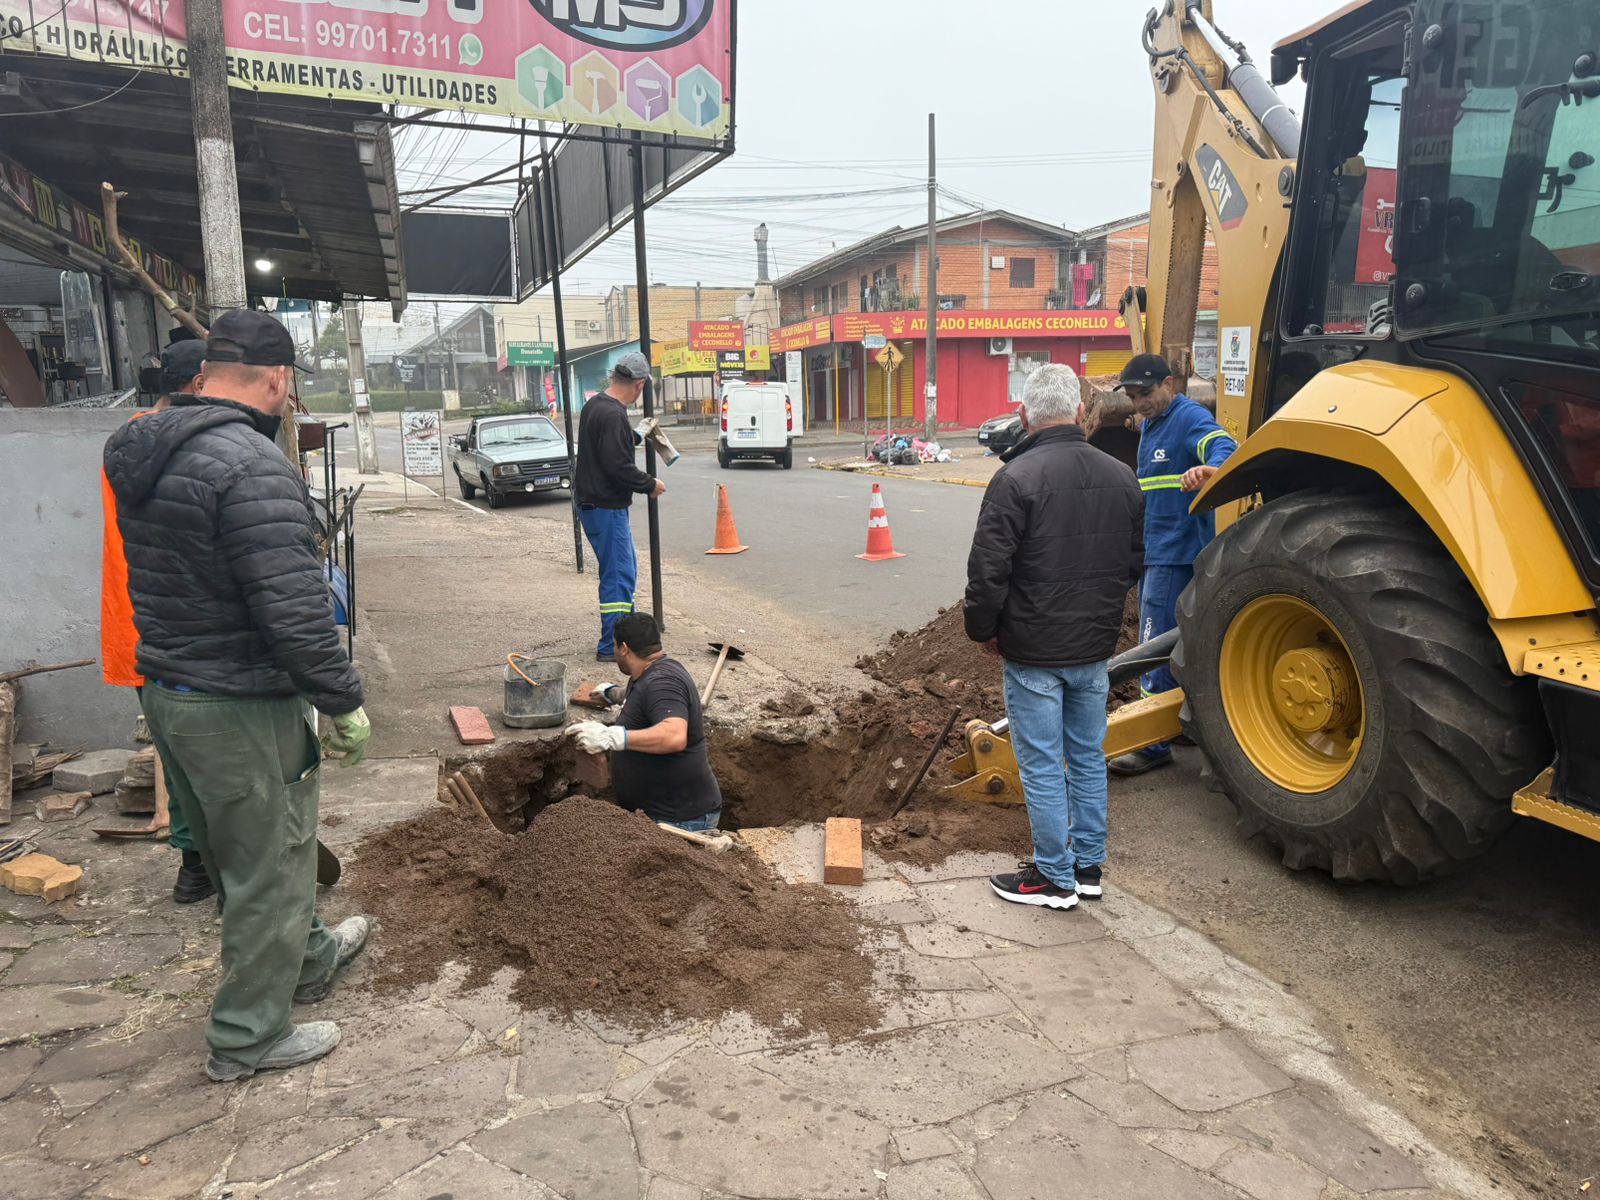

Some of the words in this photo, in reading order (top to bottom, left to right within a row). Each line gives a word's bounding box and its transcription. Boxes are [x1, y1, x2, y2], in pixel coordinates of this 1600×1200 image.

[243, 11, 306, 44] CEL:
[315, 19, 451, 60] 99701.7311
[226, 55, 363, 91] ERRAMENTAS
[382, 73, 498, 105] UTILIDADES
[1207, 159, 1233, 216] CAT
[968, 317, 1043, 330] EMBALAGENS
[1045, 316, 1108, 329] CECONELLO
[724, 352, 740, 361] BIG
[1225, 377, 1245, 393] RET-08
